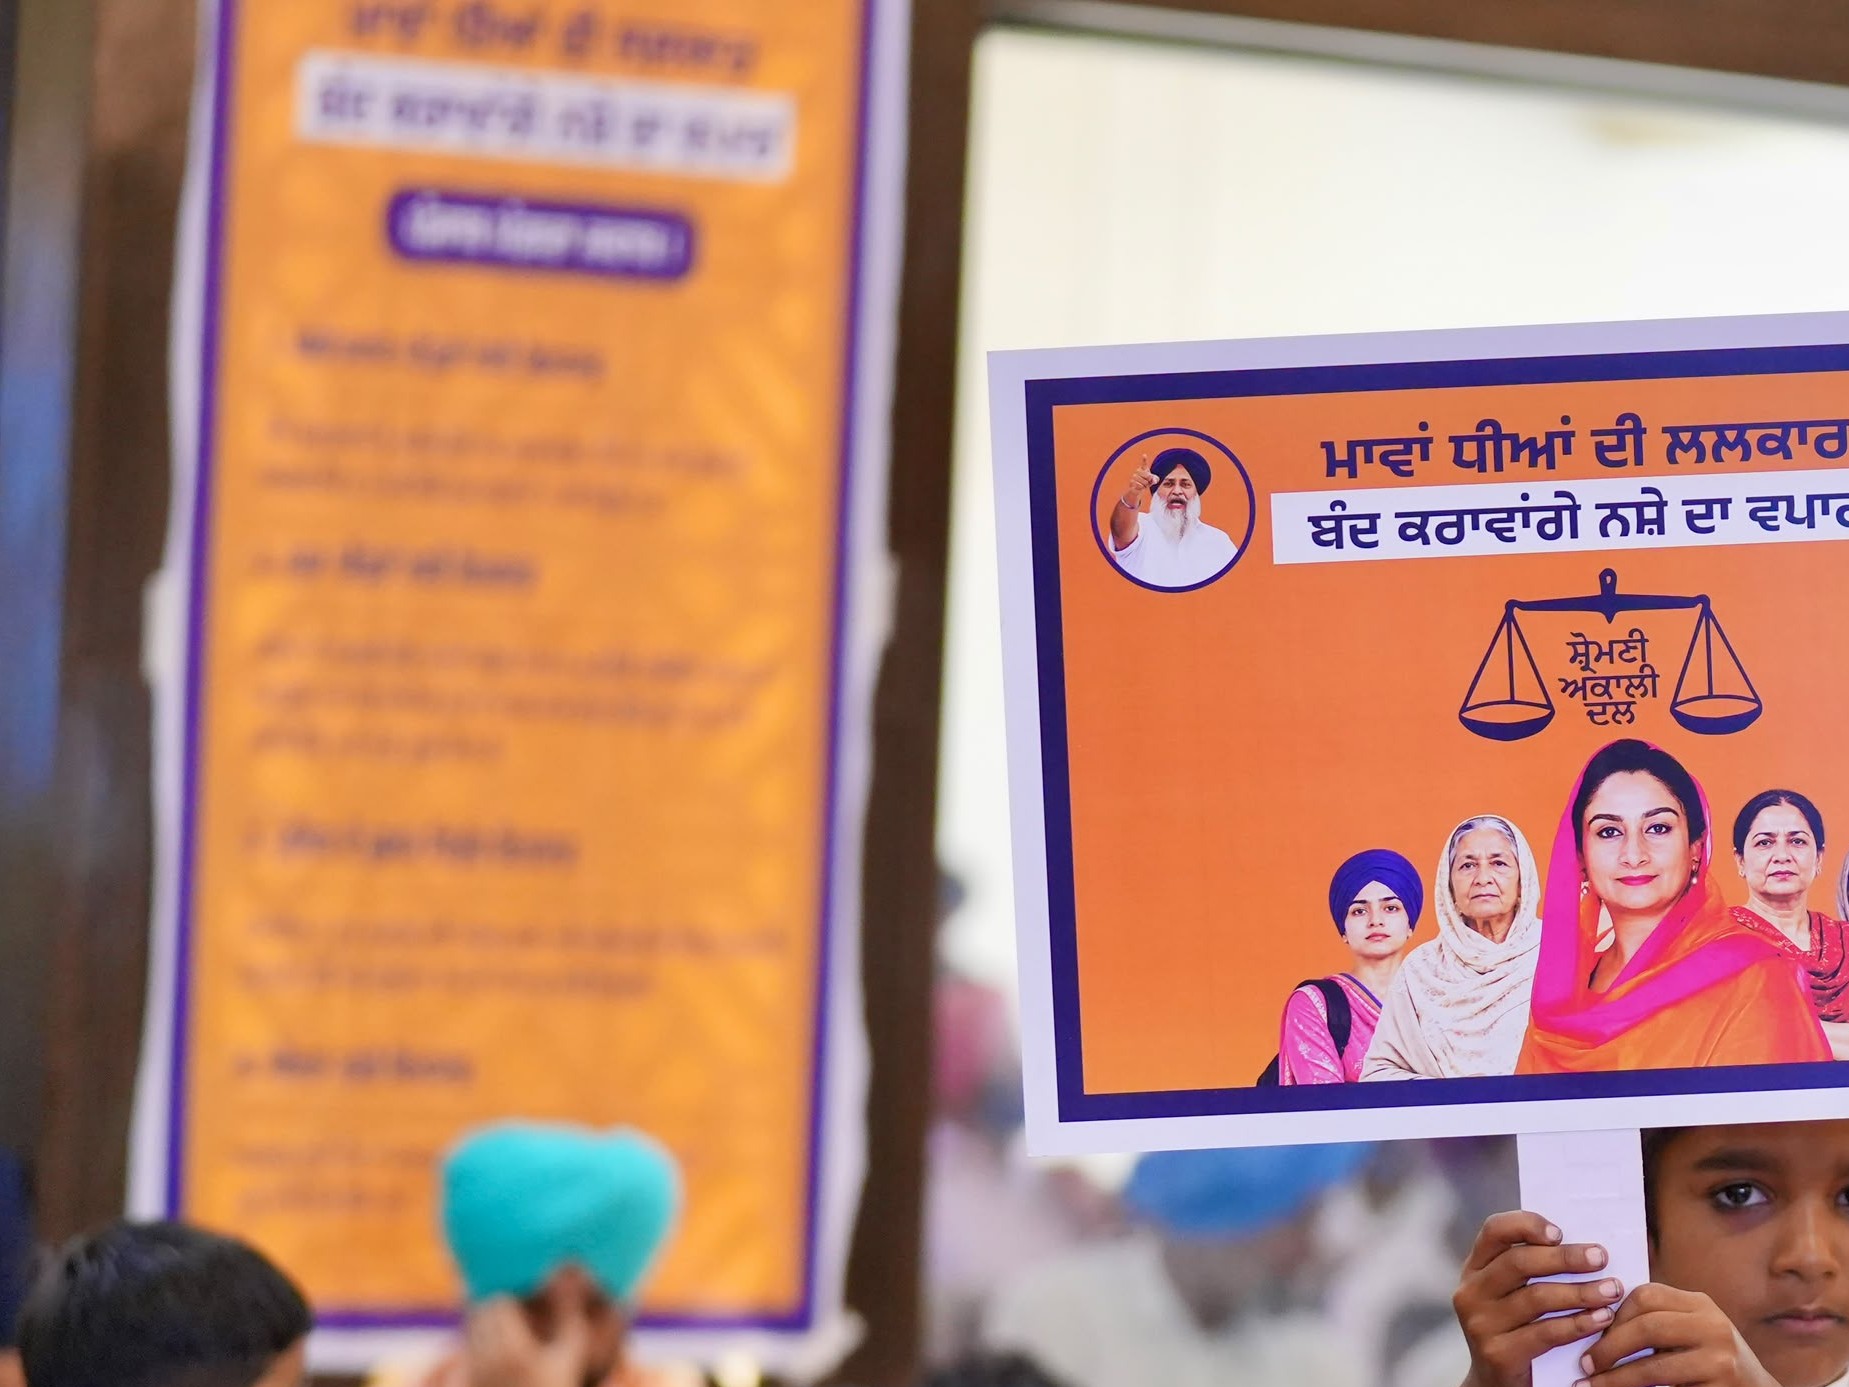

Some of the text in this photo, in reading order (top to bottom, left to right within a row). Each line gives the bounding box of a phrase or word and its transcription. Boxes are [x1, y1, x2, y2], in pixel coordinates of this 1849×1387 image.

[1320, 421, 1433, 478] ਮਾਵਾਂ
[1449, 415, 1576, 473] ਧੀਆਂ
[1590, 412, 1647, 468] ਦੀ
[1307, 500, 1381, 549] ਬੰਦ
[1394, 490, 1581, 546] ਕਰਾਵਾਂਗੇ
[1595, 487, 1668, 538] ਨਸ਼ੇ
[1682, 498, 1732, 534] ਦਾ
[1557, 663, 1660, 701] ਅਕਾਲੀ
[1583, 701, 1637, 726] ਦਲ
